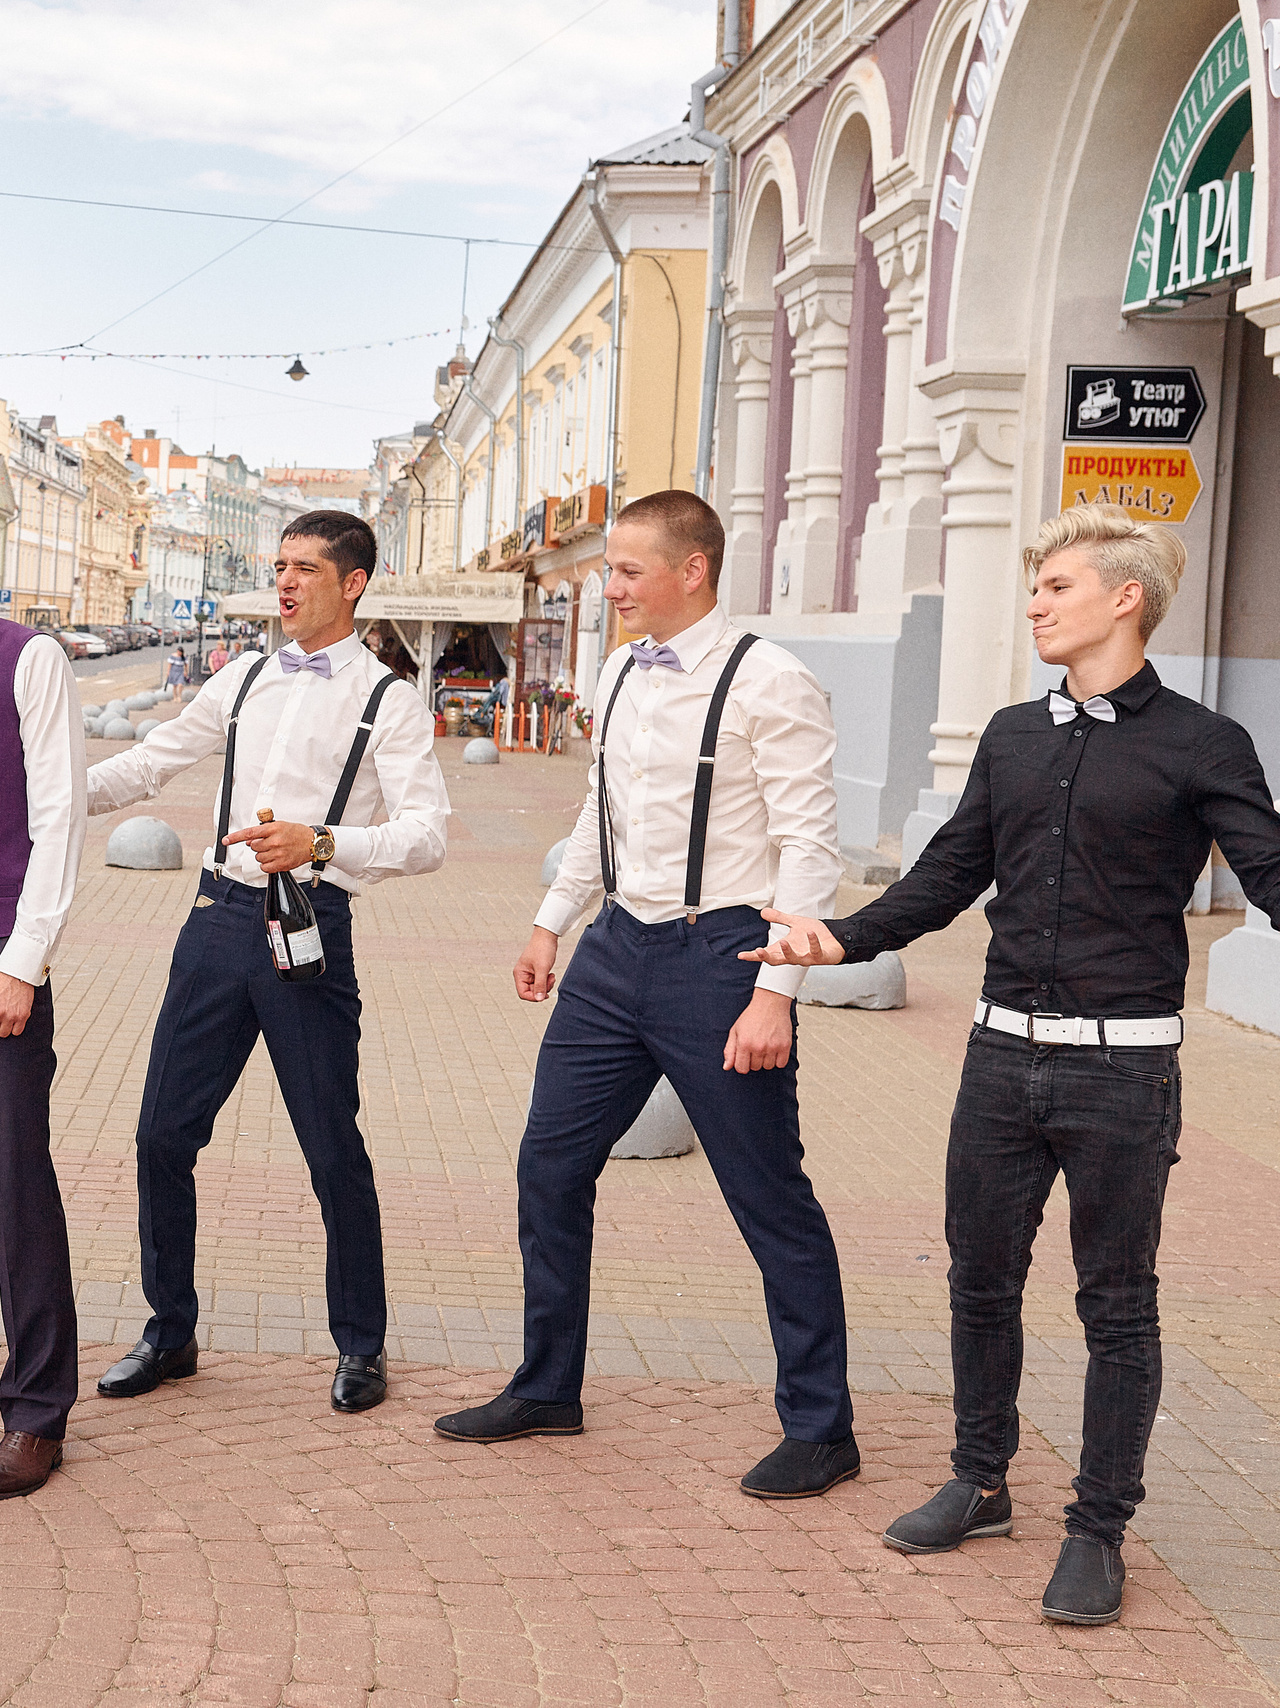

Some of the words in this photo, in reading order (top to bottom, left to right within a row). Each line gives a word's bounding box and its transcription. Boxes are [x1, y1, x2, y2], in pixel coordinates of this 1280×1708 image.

[939, 0, 1016, 231] ПРОД
[1131, 379, 1186, 404] Театр
[1129, 406, 1187, 428] УТЮГ
[1067, 456, 1187, 478] ПРОДУКТЫ
